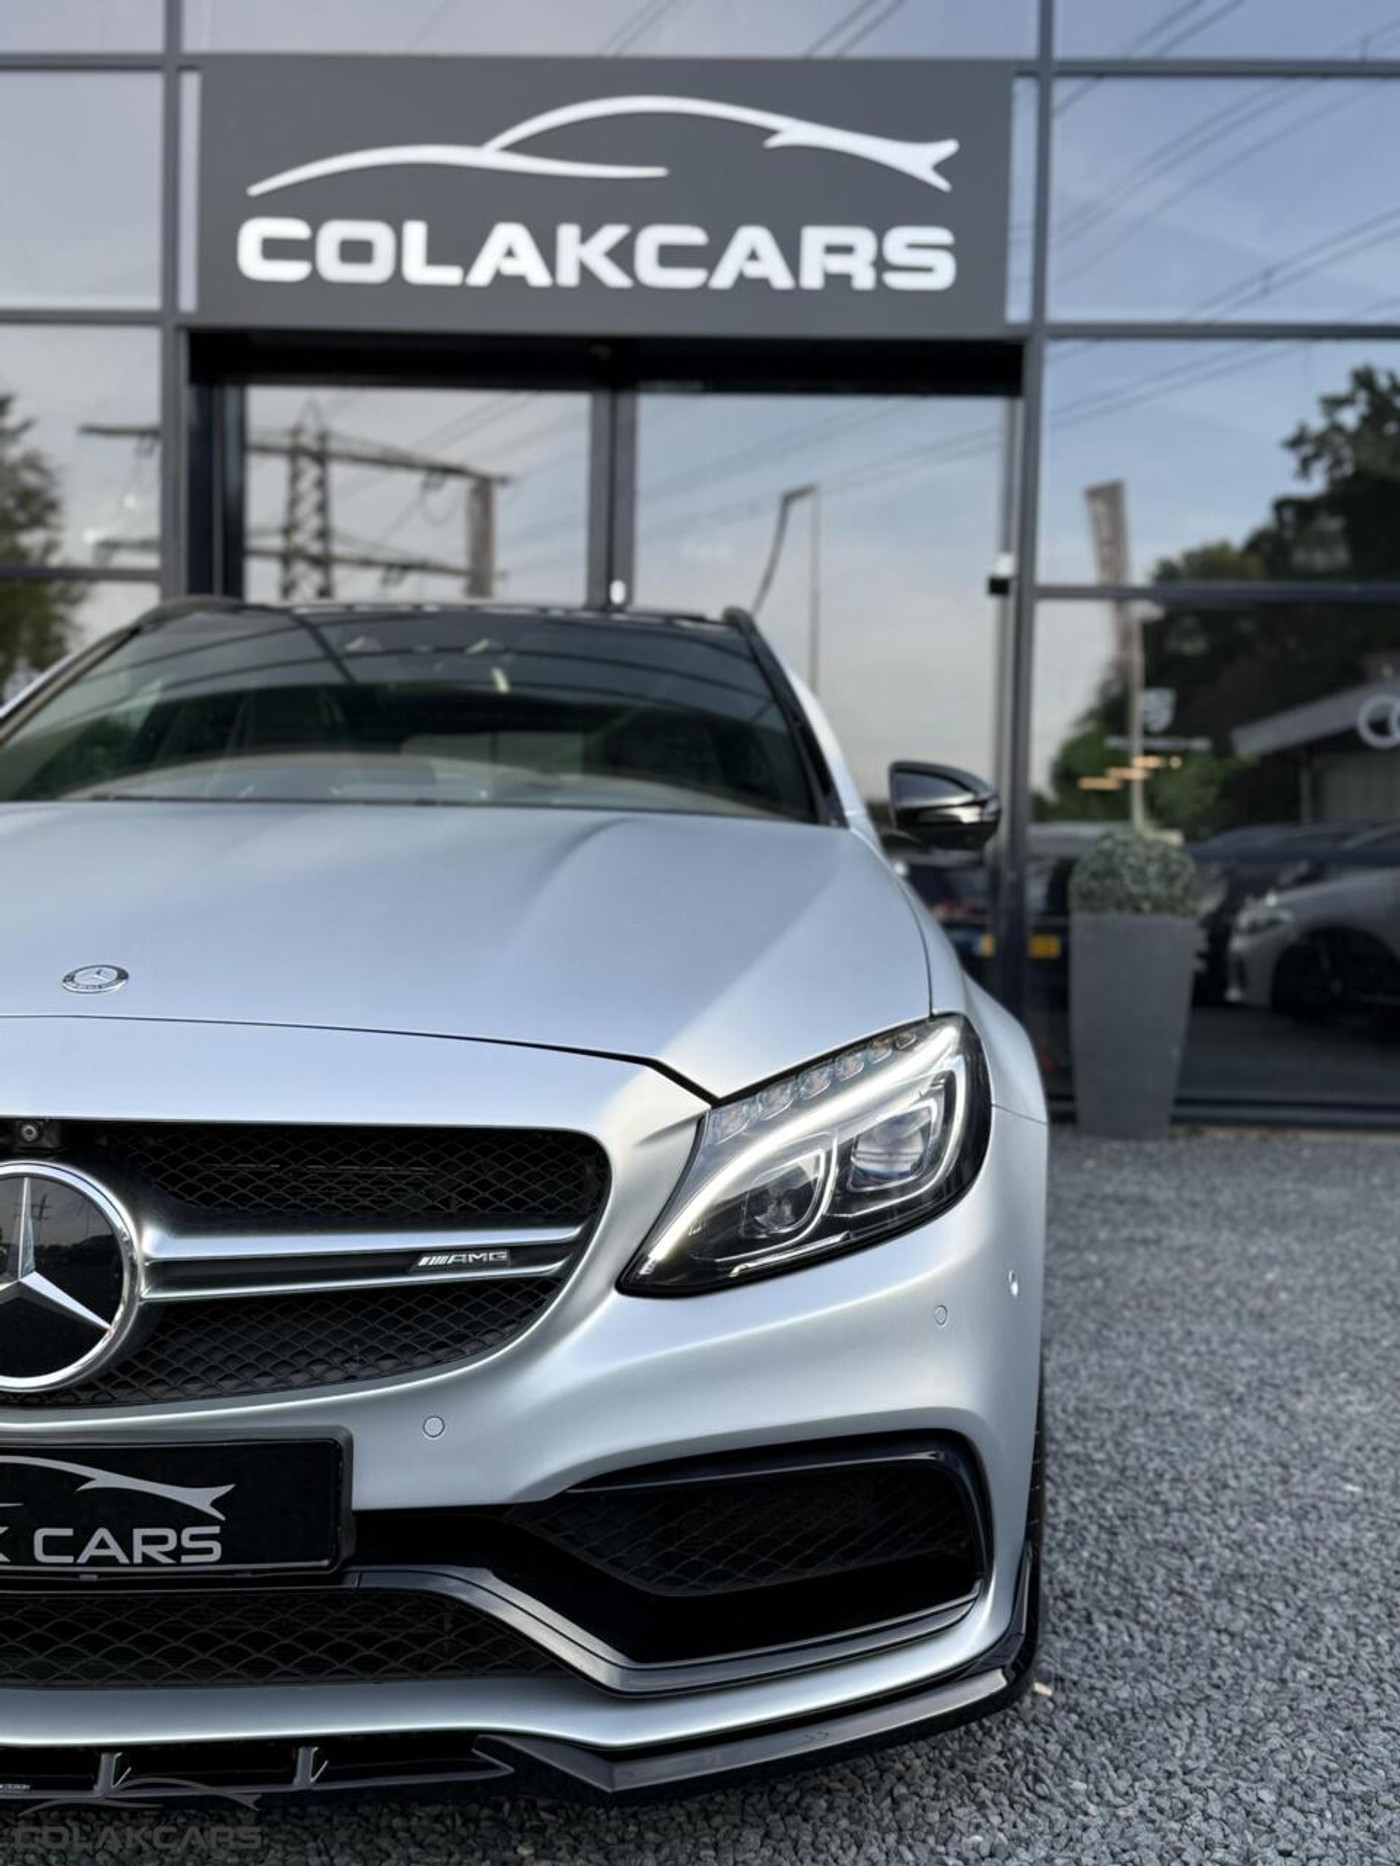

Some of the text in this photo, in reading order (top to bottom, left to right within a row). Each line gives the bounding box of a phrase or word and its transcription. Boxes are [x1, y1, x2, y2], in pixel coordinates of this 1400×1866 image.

[237, 216, 957, 291] COLAKCARS
[446, 1250, 508, 1265] AMG
[33, 1525, 222, 1564] CARS
